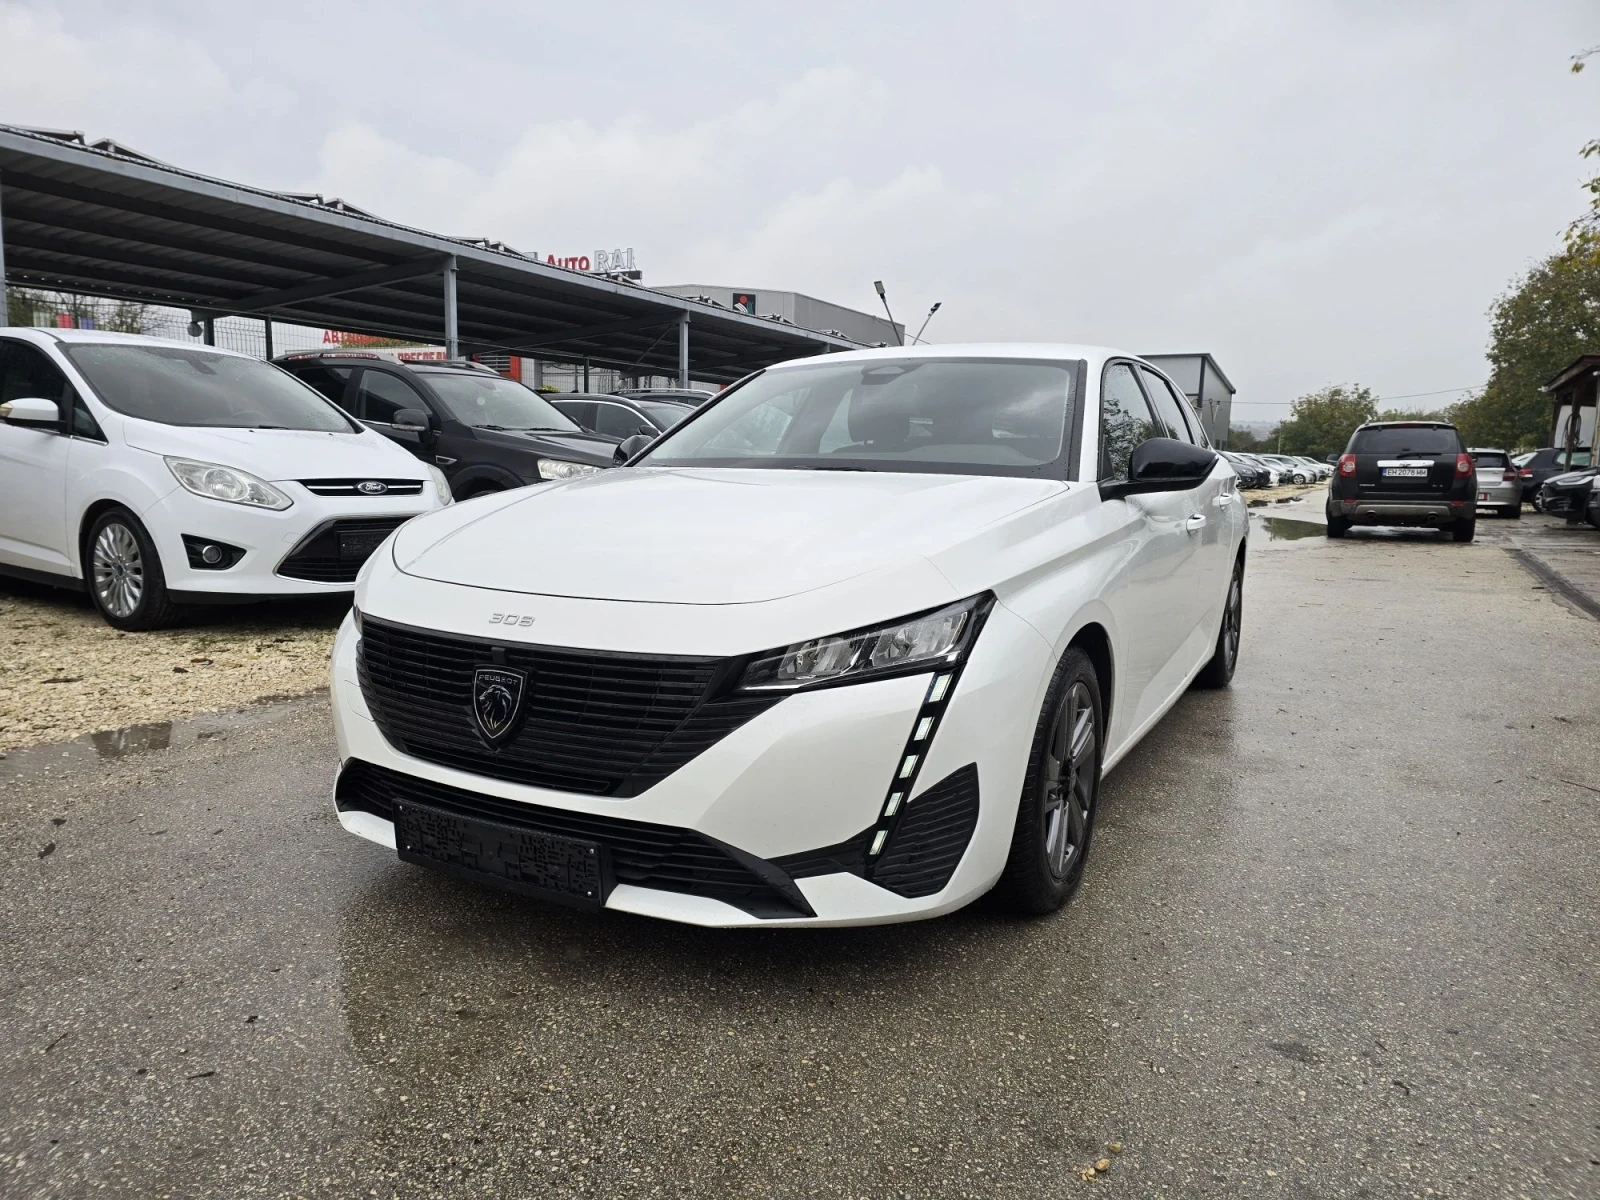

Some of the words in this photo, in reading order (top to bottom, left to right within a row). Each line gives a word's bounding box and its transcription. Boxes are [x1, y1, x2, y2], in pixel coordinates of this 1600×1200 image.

[547, 254, 590, 271] AUTO
[594, 247, 633, 271] RAI
[488, 613, 536, 627] 308
[478, 674, 518, 685] PEUGEOT
